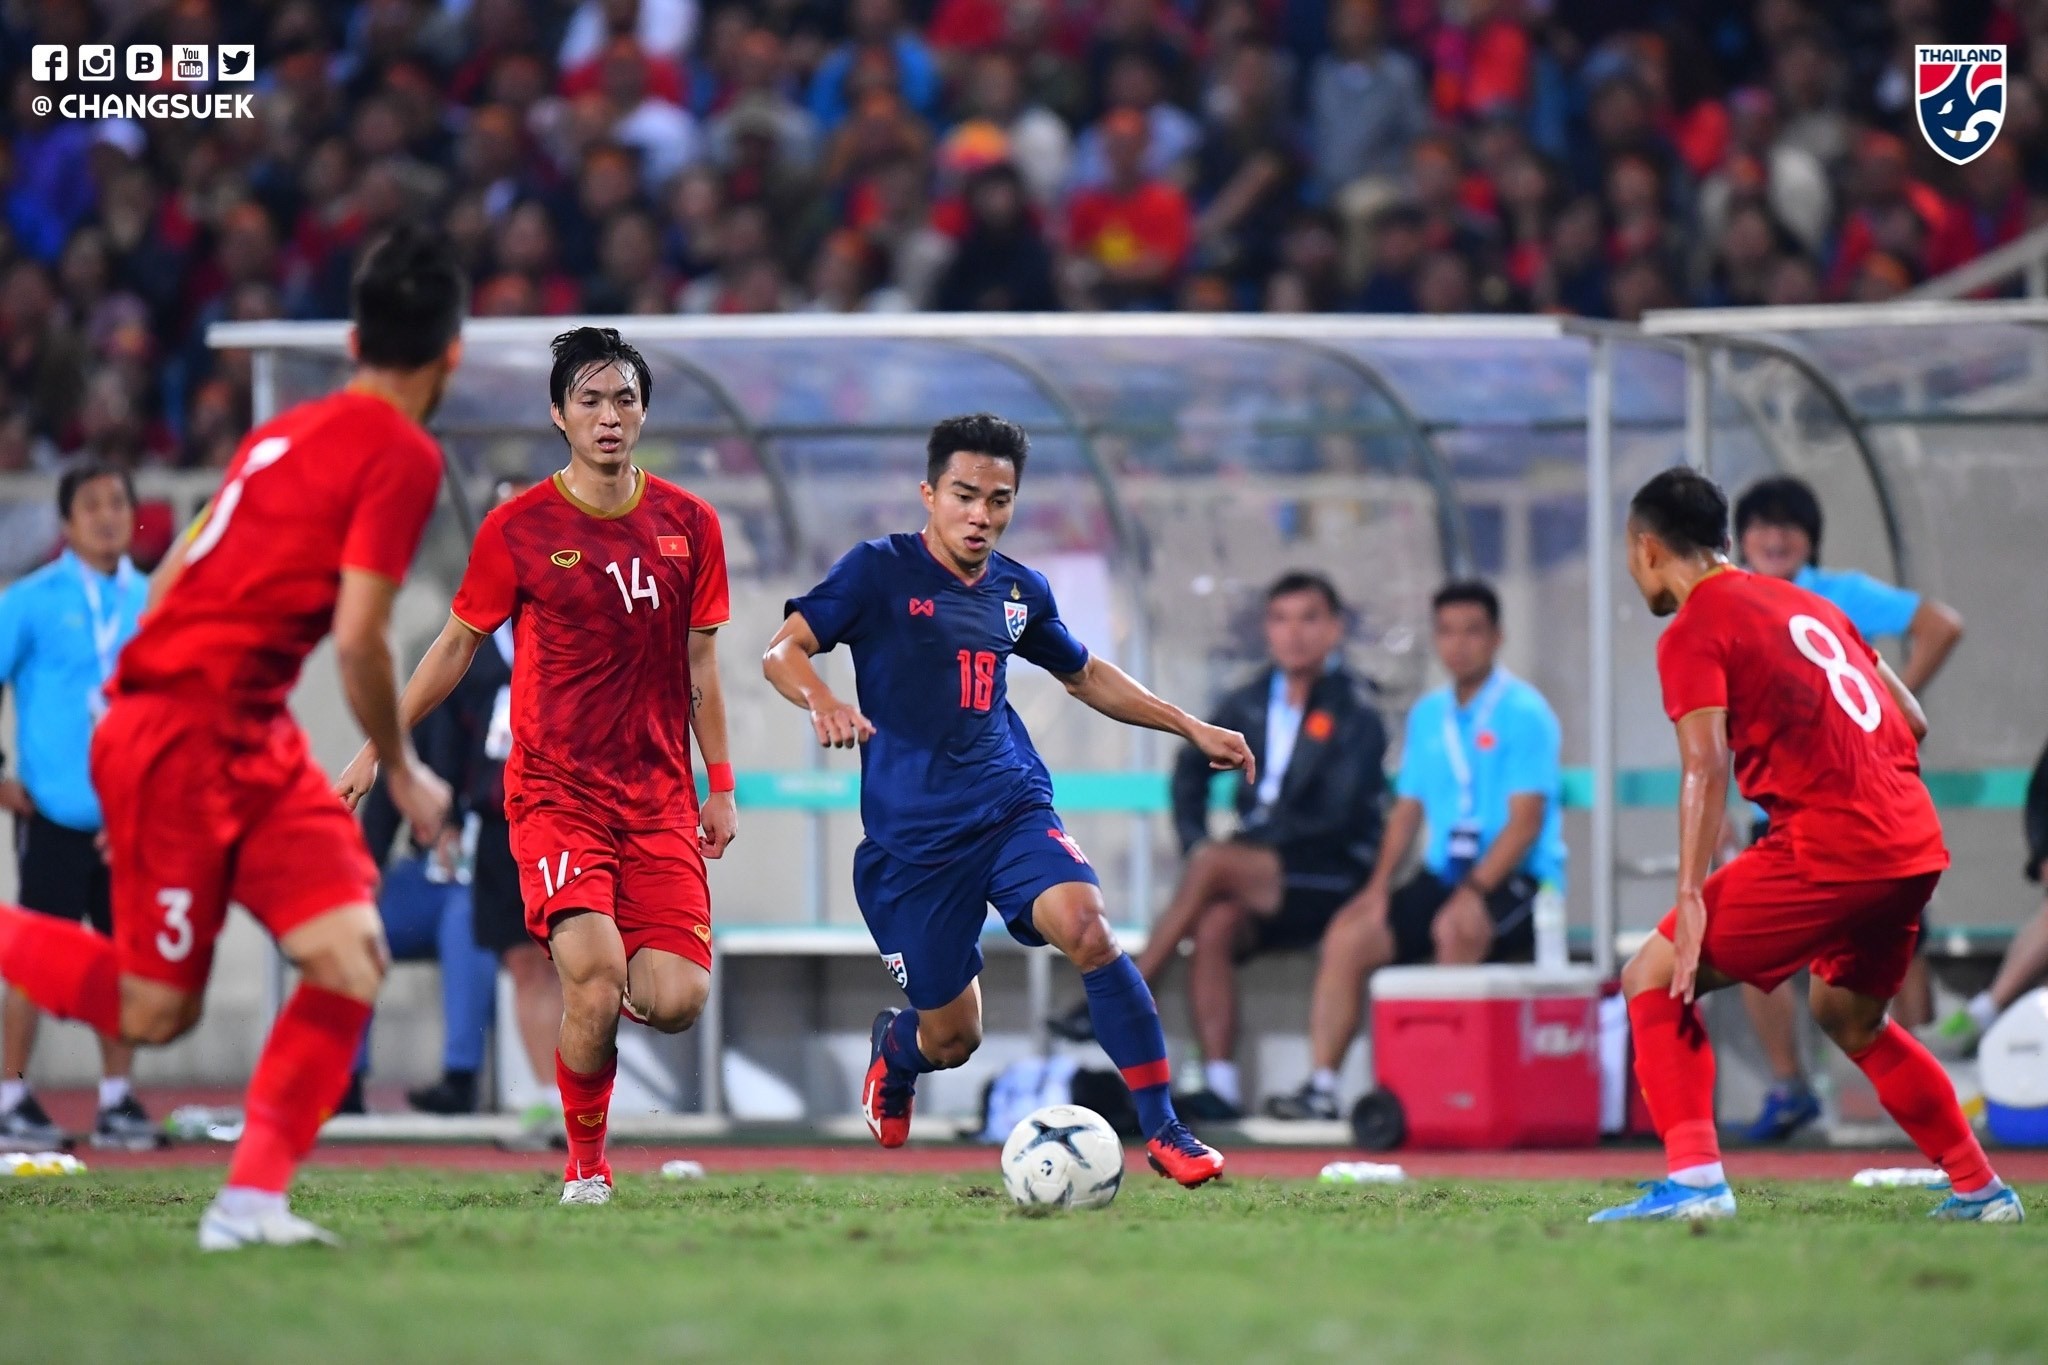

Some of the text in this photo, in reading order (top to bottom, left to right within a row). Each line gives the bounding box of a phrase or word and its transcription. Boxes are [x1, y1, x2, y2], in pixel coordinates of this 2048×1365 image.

[605, 557, 660, 614] 14
[957, 649, 997, 712] 18
[1788, 614, 1882, 733] 8
[156, 887, 194, 963] 3
